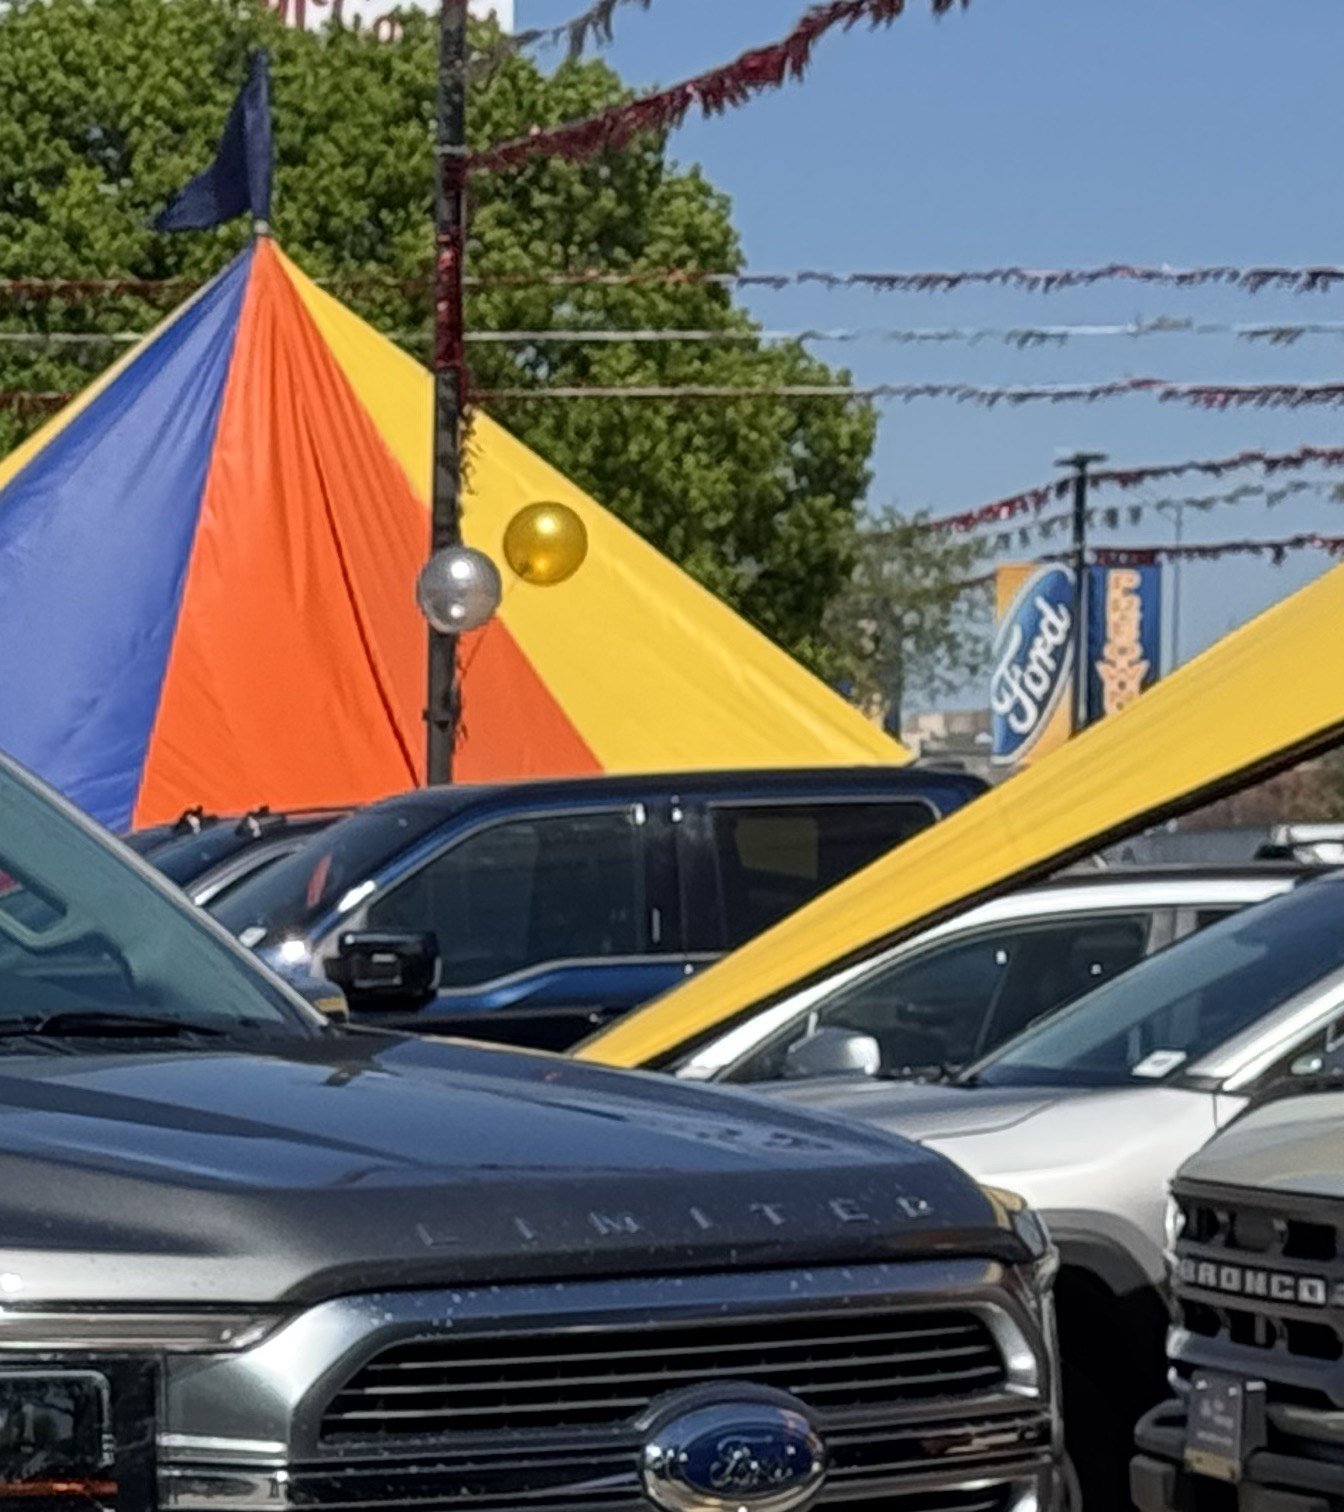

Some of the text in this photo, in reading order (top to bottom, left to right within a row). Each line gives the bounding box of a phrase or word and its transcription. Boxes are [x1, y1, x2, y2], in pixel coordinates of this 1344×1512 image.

[992, 596, 1071, 734] Ford
[415, 1194, 933, 1248] LIMITED
[1179, 1257, 1326, 1305] BRONCO
